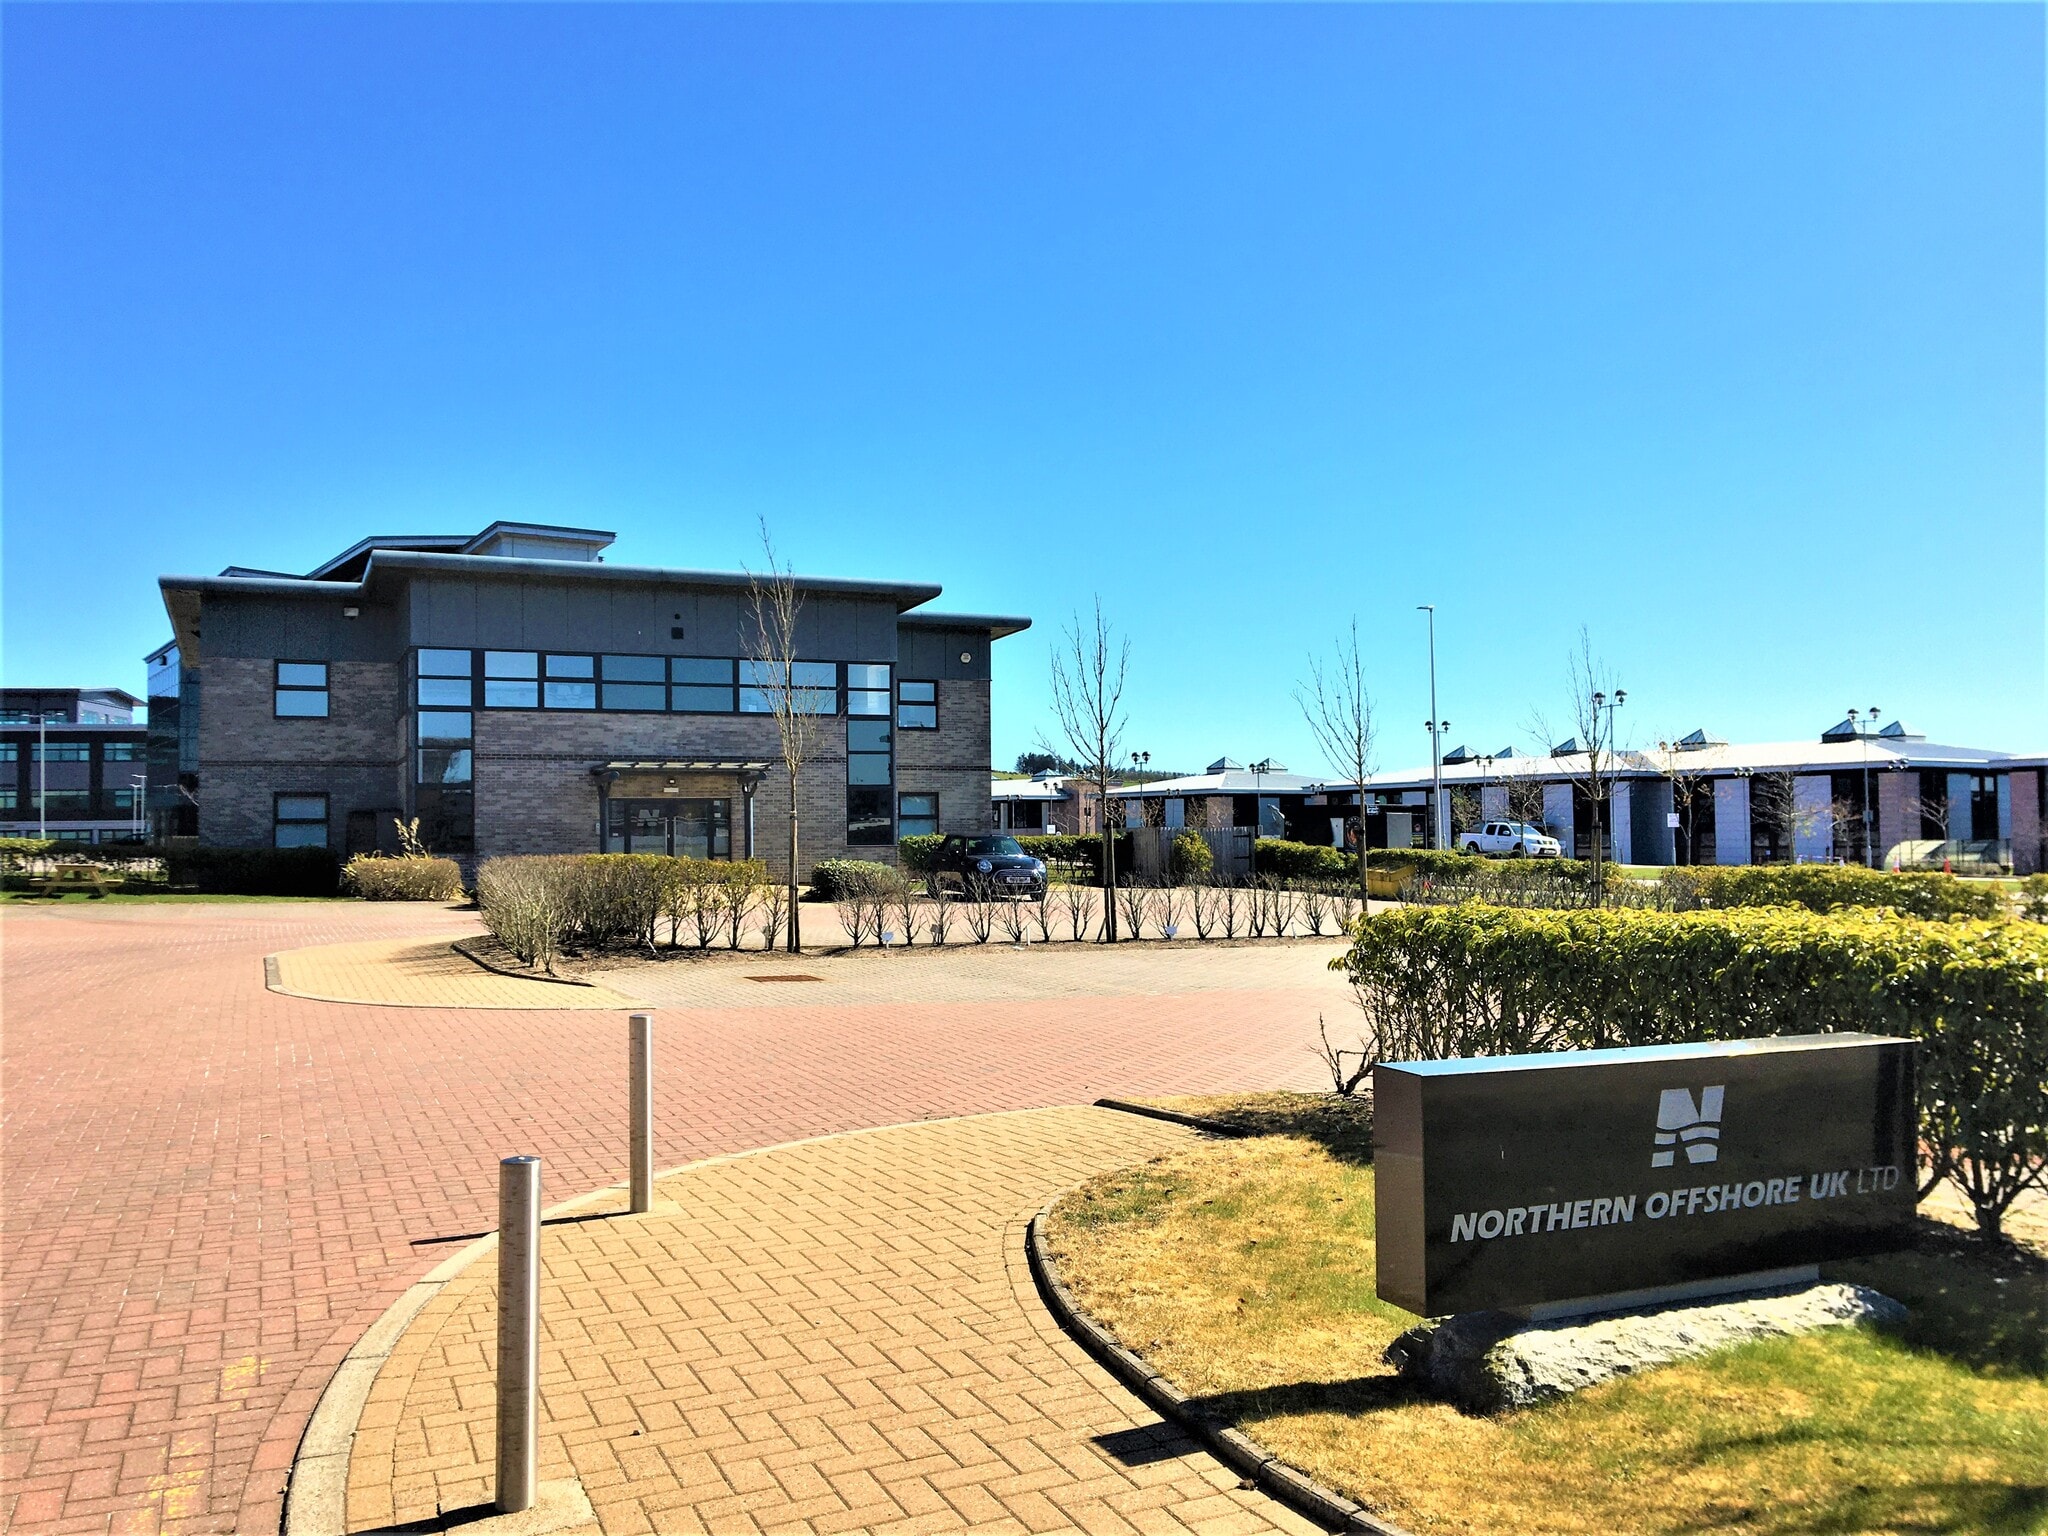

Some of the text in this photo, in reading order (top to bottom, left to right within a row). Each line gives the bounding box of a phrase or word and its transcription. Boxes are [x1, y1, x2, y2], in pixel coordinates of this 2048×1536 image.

[1450, 1166, 1899, 1243] NORTHERN OFFSHORE UK LTD
